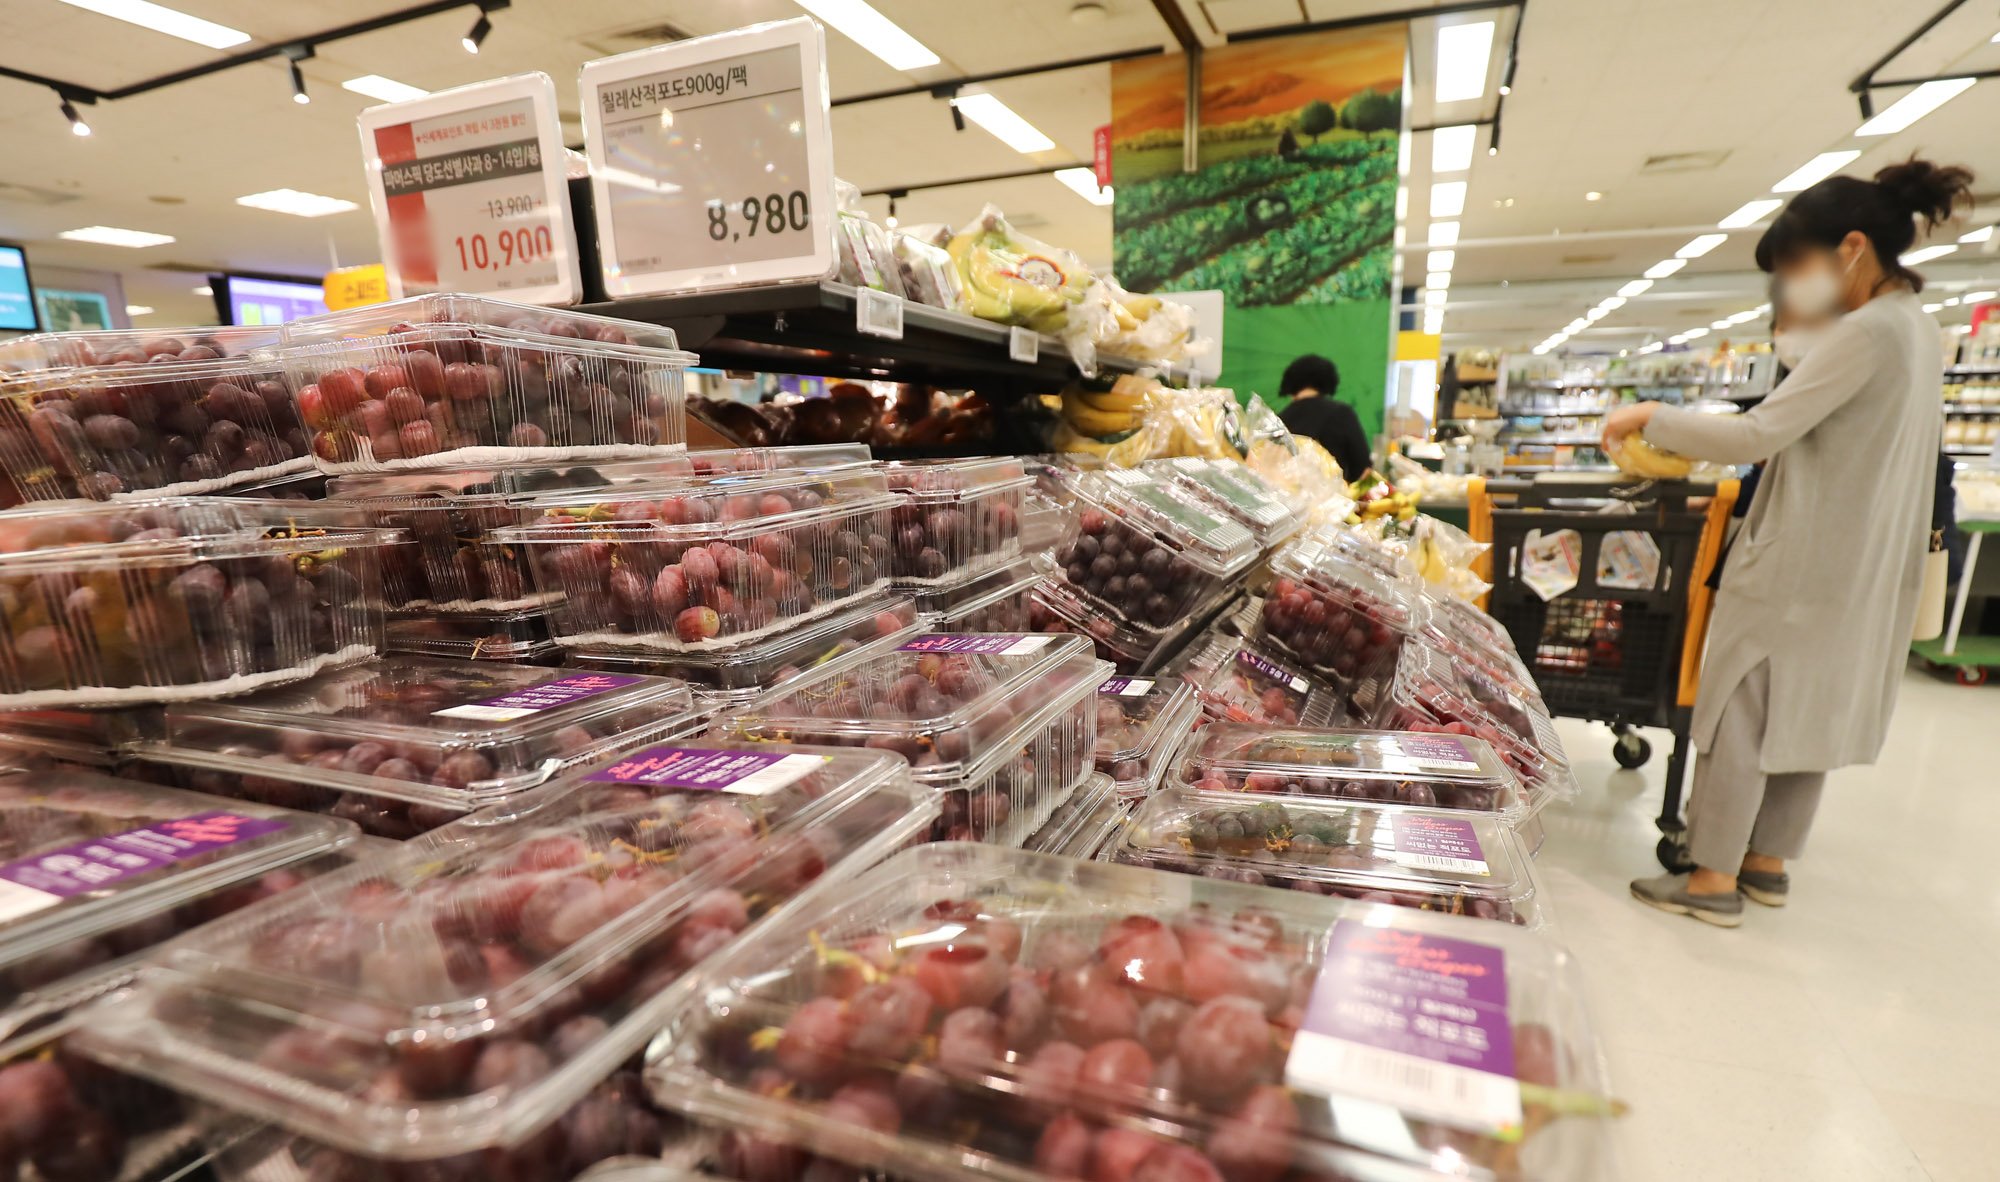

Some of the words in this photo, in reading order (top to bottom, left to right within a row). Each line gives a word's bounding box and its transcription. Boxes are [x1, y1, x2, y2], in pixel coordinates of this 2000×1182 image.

[602, 64, 748, 114] 칠레산적포도900g/팩
[423, 153, 482, 183] 당도선별사과
[708, 190, 809, 243] 8,980
[455, 225, 553, 272] 10,900
